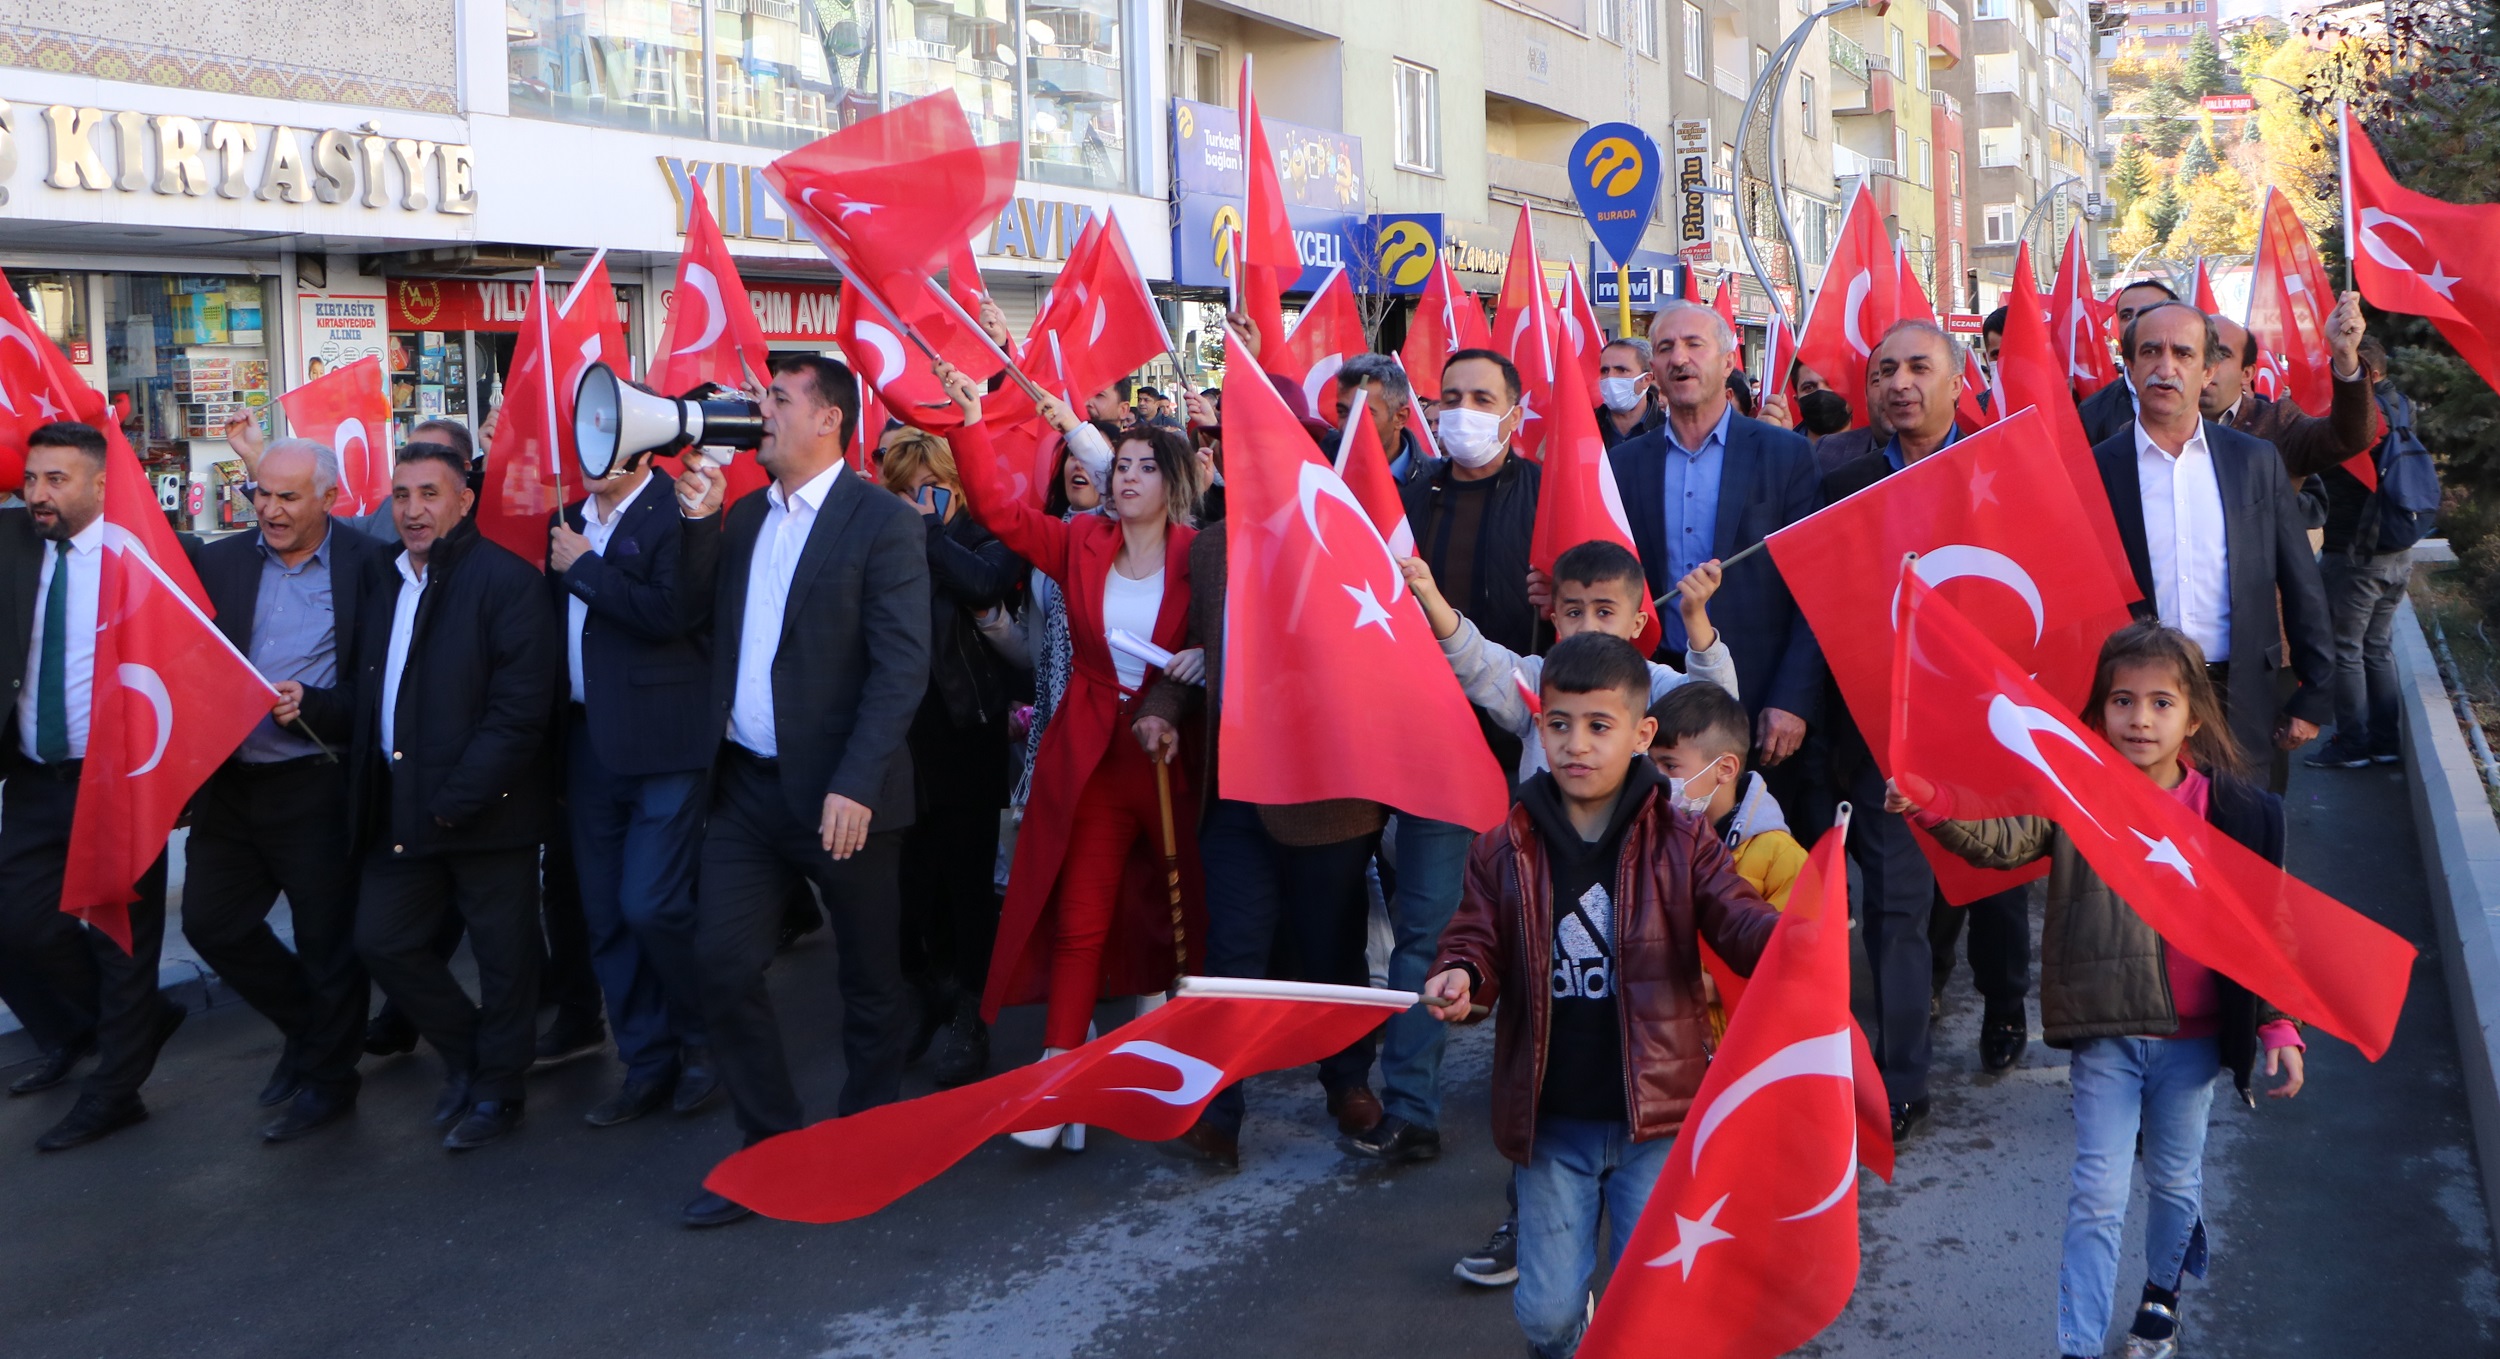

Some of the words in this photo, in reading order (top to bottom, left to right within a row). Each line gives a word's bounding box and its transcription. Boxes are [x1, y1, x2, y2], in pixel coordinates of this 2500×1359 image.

[42, 103, 479, 215] KIRTASİYE
[1205, 148, 1237, 172] bağlan
[1597, 209, 1637, 221] BURADA
[1292, 231, 1346, 268] KCELL
[1599, 279, 1648, 296] mvi
[315, 300, 375, 317] KIRTASİYE
[796, 292, 840, 334] AVM
[1951, 320, 1981, 328] ECZANE
[330, 329, 362, 341] ALINIR
